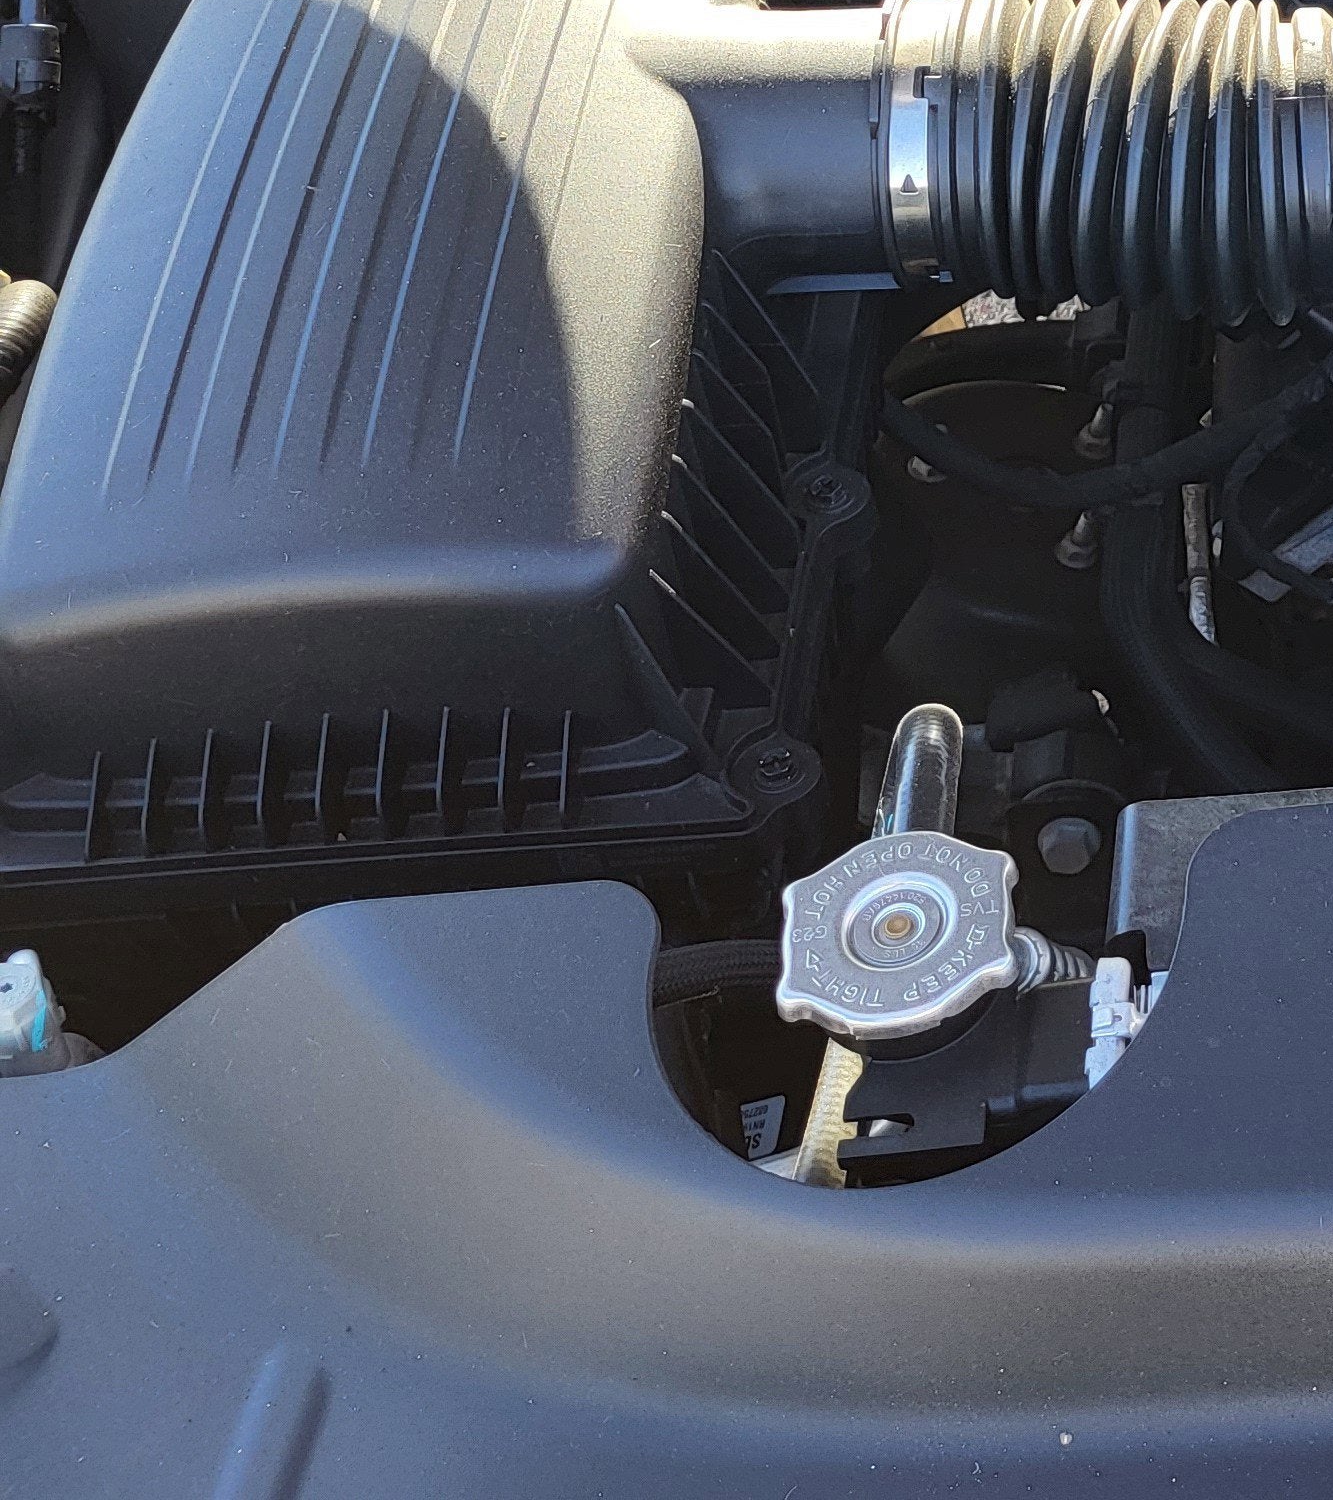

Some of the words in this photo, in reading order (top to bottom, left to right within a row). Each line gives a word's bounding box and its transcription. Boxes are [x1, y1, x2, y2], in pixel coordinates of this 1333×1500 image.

[842, 841, 915, 879] OPEN
[921, 842, 970, 873] NOT
[803, 875, 845, 921] HOT
[962, 866, 993, 898] DO
[959, 899, 999, 918] TVS
[791, 924, 829, 943] G23
[811, 970, 884, 1007] TIGHT
[902, 949, 975, 1001] KEEP
